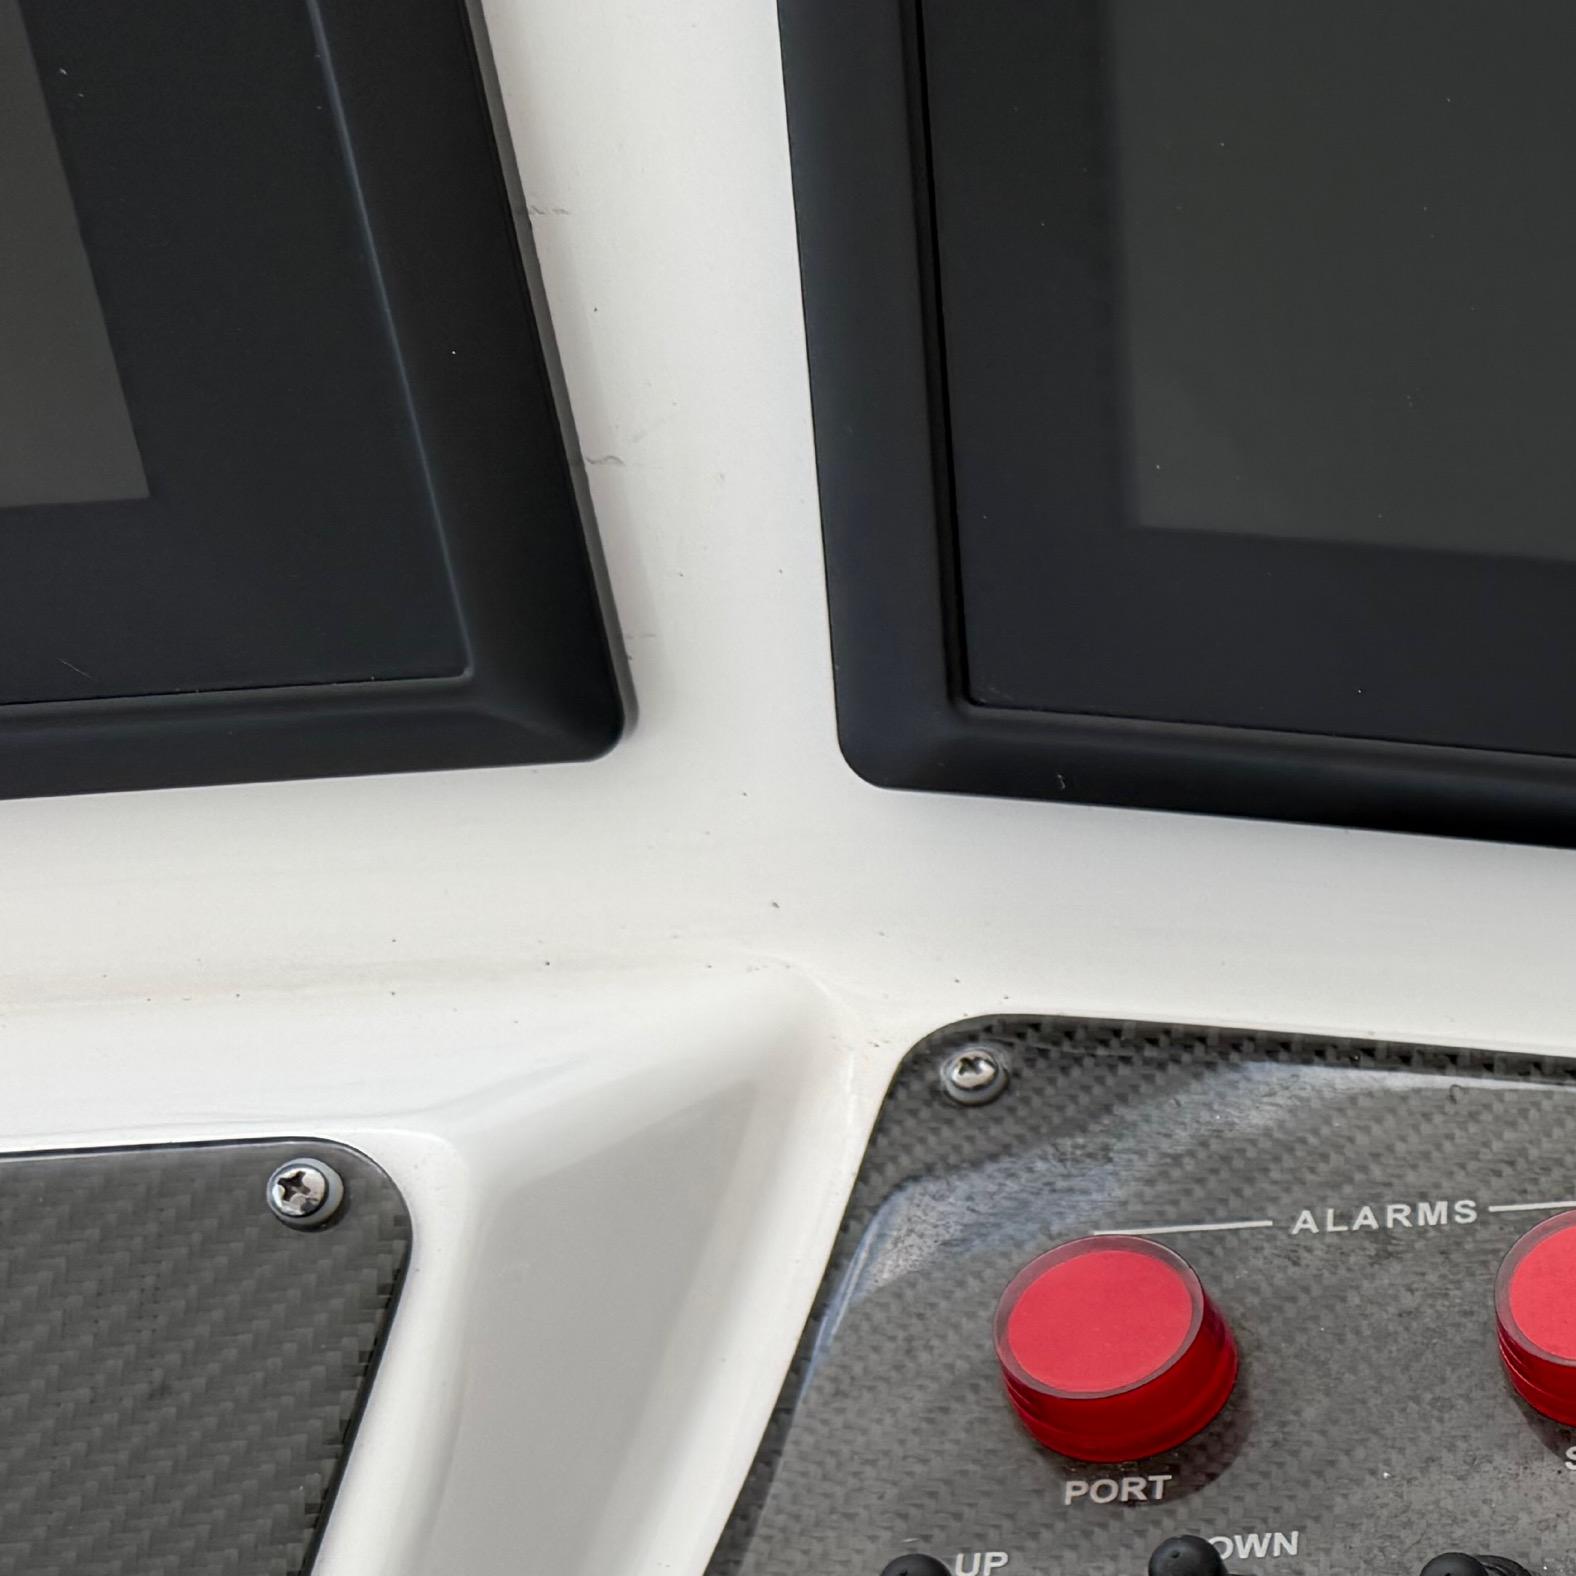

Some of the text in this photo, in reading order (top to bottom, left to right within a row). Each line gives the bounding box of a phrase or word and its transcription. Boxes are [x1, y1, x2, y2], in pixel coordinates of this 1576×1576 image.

[1291, 1199, 1479, 1235] ALARMS
[1063, 1474, 1173, 1506] PORT
[1208, 1530, 1300, 1560] OWN
